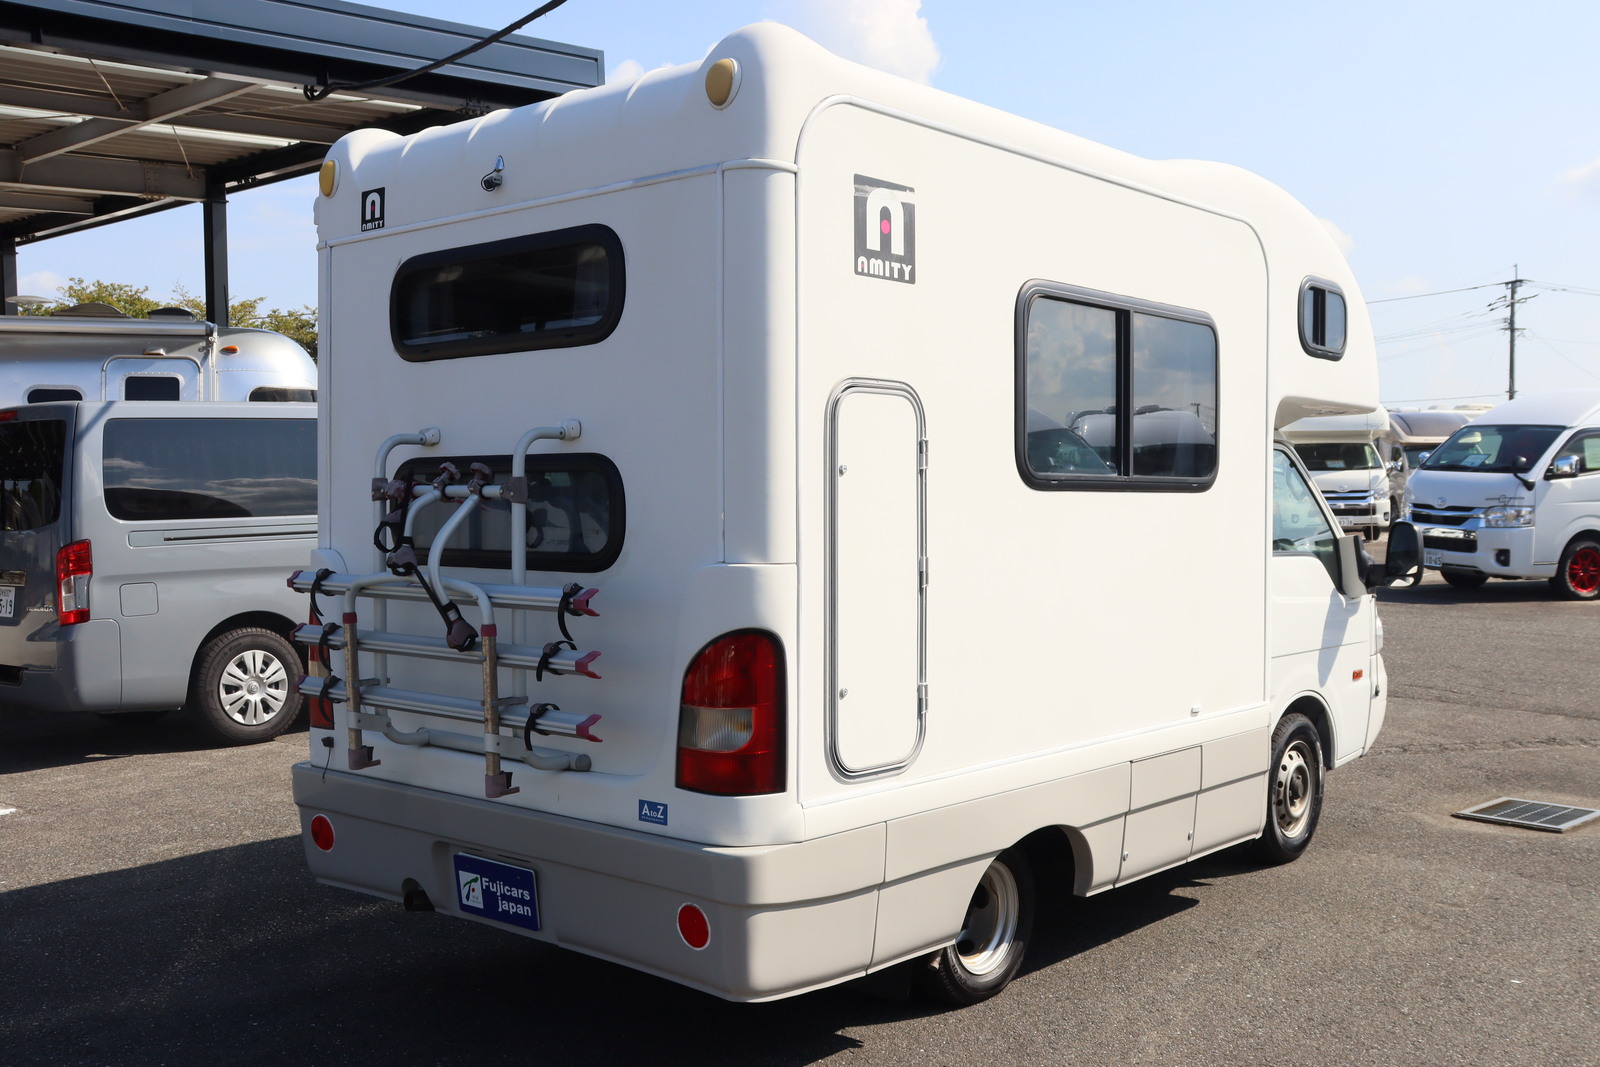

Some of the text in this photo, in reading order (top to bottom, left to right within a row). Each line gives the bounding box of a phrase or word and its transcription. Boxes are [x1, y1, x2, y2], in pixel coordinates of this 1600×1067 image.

[362, 220, 383, 231] AMITY
[857, 256, 912, 281] AMITY
[481, 877, 531, 901] Fujicars
[498, 897, 532, 917] japan
